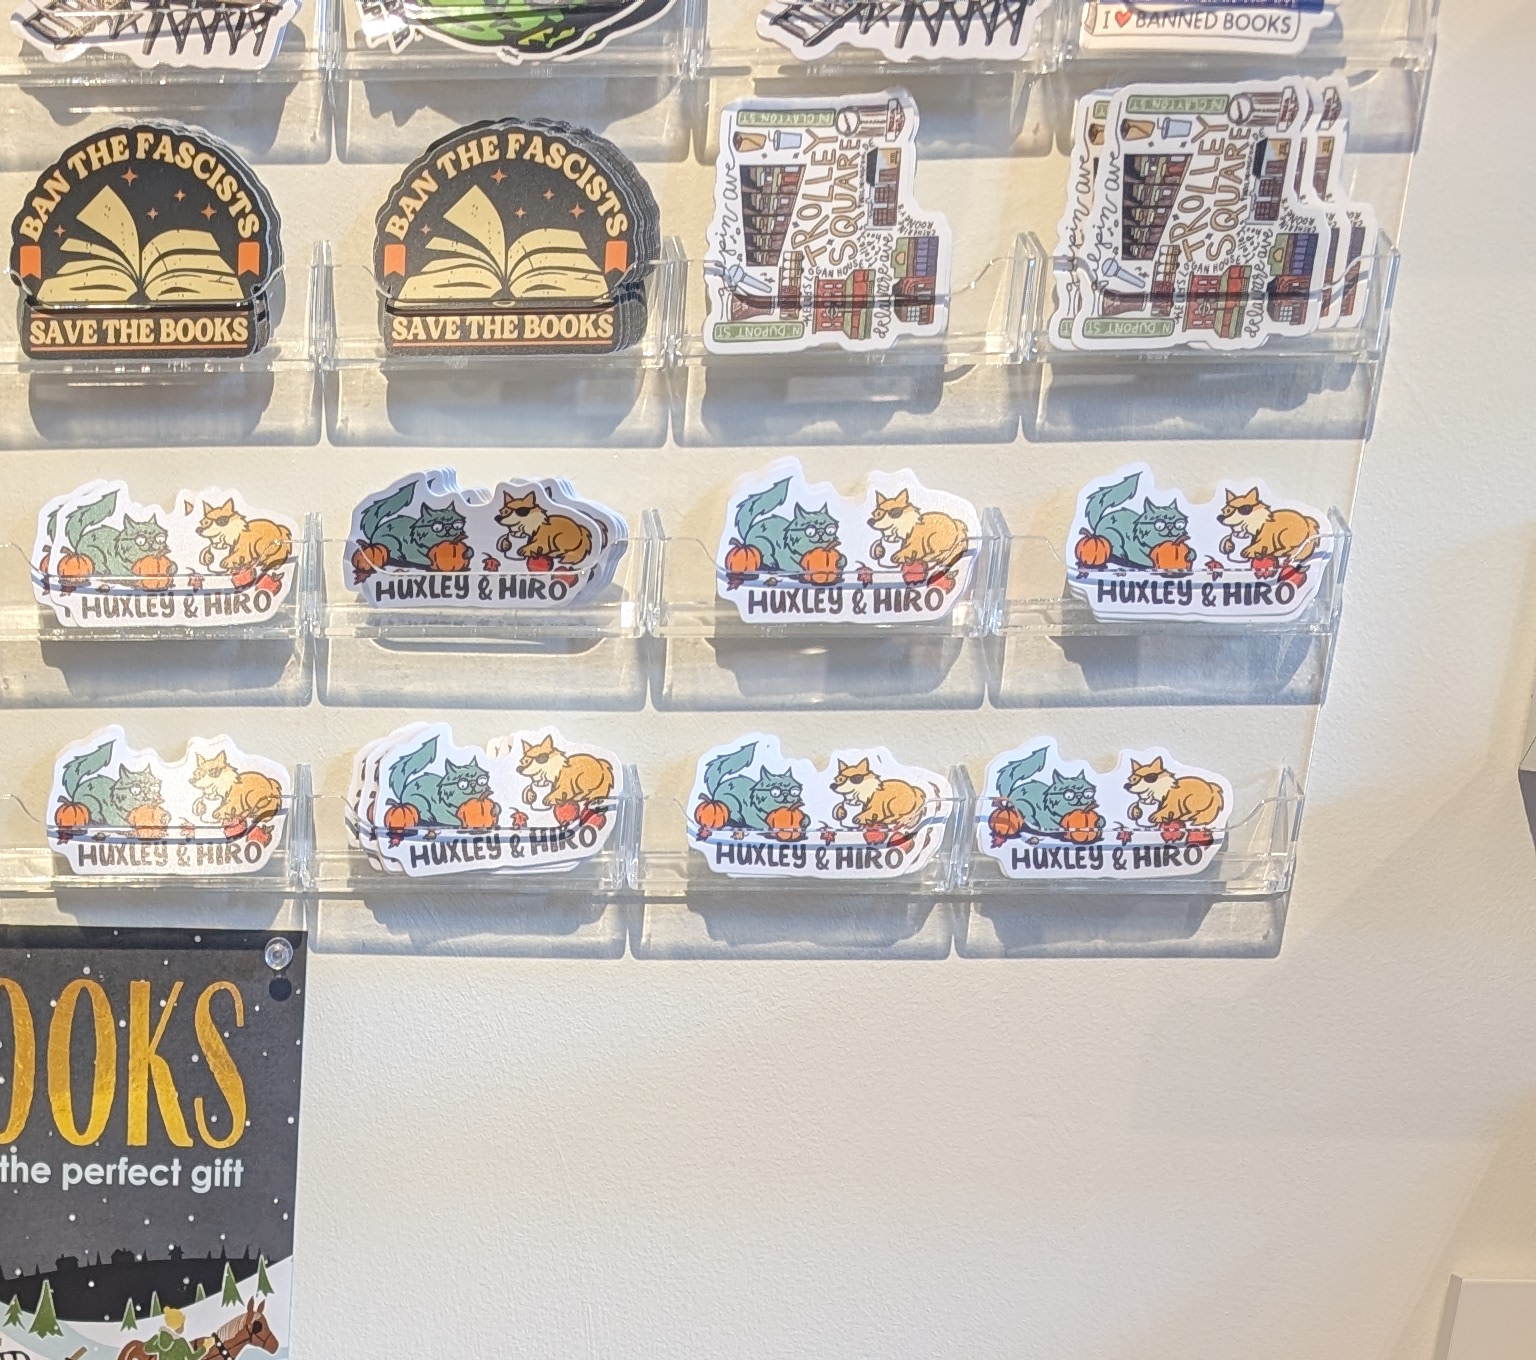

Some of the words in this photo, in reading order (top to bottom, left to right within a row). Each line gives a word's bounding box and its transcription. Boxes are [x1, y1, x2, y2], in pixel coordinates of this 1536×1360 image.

[1103, 13, 1109, 29] I
[1136, 11, 1217, 31] BANNED
[1223, 13, 1291, 34] BOOKS
[19, 172, 70, 244] BAN
[66, 130, 130, 179] THE
[136, 131, 262, 238] FASCISTS
[385, 172, 438, 242] BAN
[435, 131, 500, 180] THE
[506, 131, 628, 238] FASCISTS
[791, 129, 838, 266] TROLLEY
[829, 139, 865, 266] SQUARE
[1169, 114, 1229, 262] TROLLEY
[1207, 126, 1251, 261] SQUARE
[30, 319, 99, 346] SAVE
[103, 319, 155, 344] THE
[158, 316, 249, 342] BOOKS
[392, 316, 462, 342] SAVE
[465, 314, 519, 339] THE
[522, 312, 614, 339] BOOKS
[1097, 578, 1192, 607] HUXLEY
[1201, 583, 1217, 607] &
[1222, 581, 1295, 607] HIRO
[0, 1155, 51, 1183] the
[62, 1156, 181, 1190] perfect
[191, 1159, 244, 1193] gift
